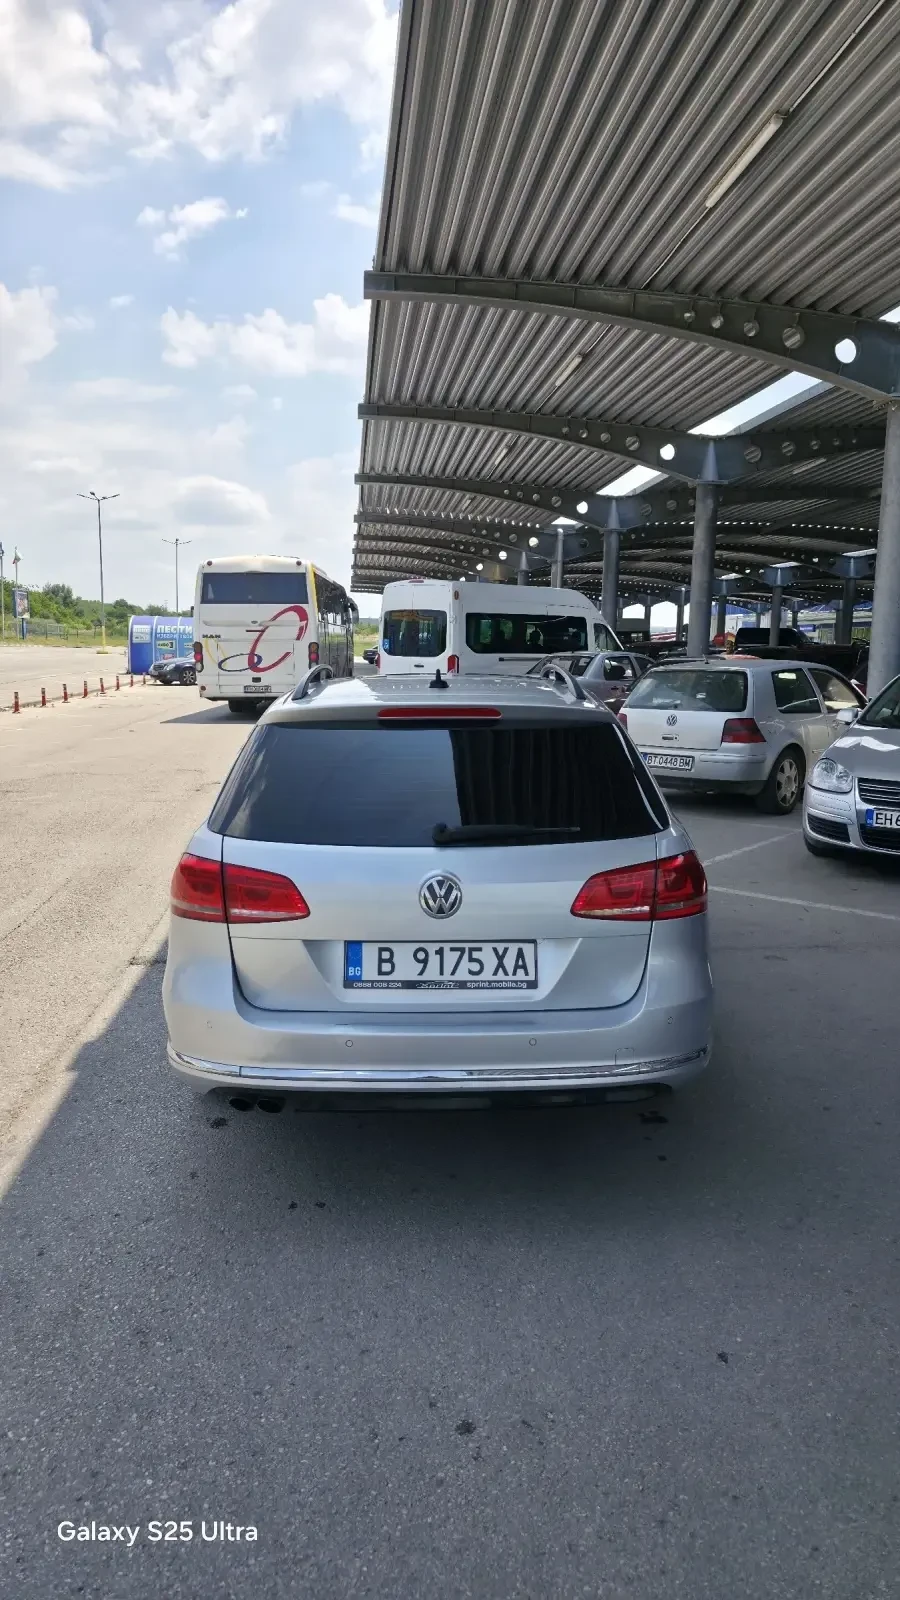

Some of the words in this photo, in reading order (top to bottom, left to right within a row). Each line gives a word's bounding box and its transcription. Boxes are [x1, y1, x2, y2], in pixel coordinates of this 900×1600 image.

[647, 755, 658, 765] BT
[659, 756, 678, 767] 0448
[875, 812, 893, 826] EH
[377, 946, 396, 976] B
[412, 946, 485, 977] 9175
[491, 946, 530, 977] XA
[348, 966, 361, 976] BG
[466, 981, 527, 989] sprint.mobile.bg
